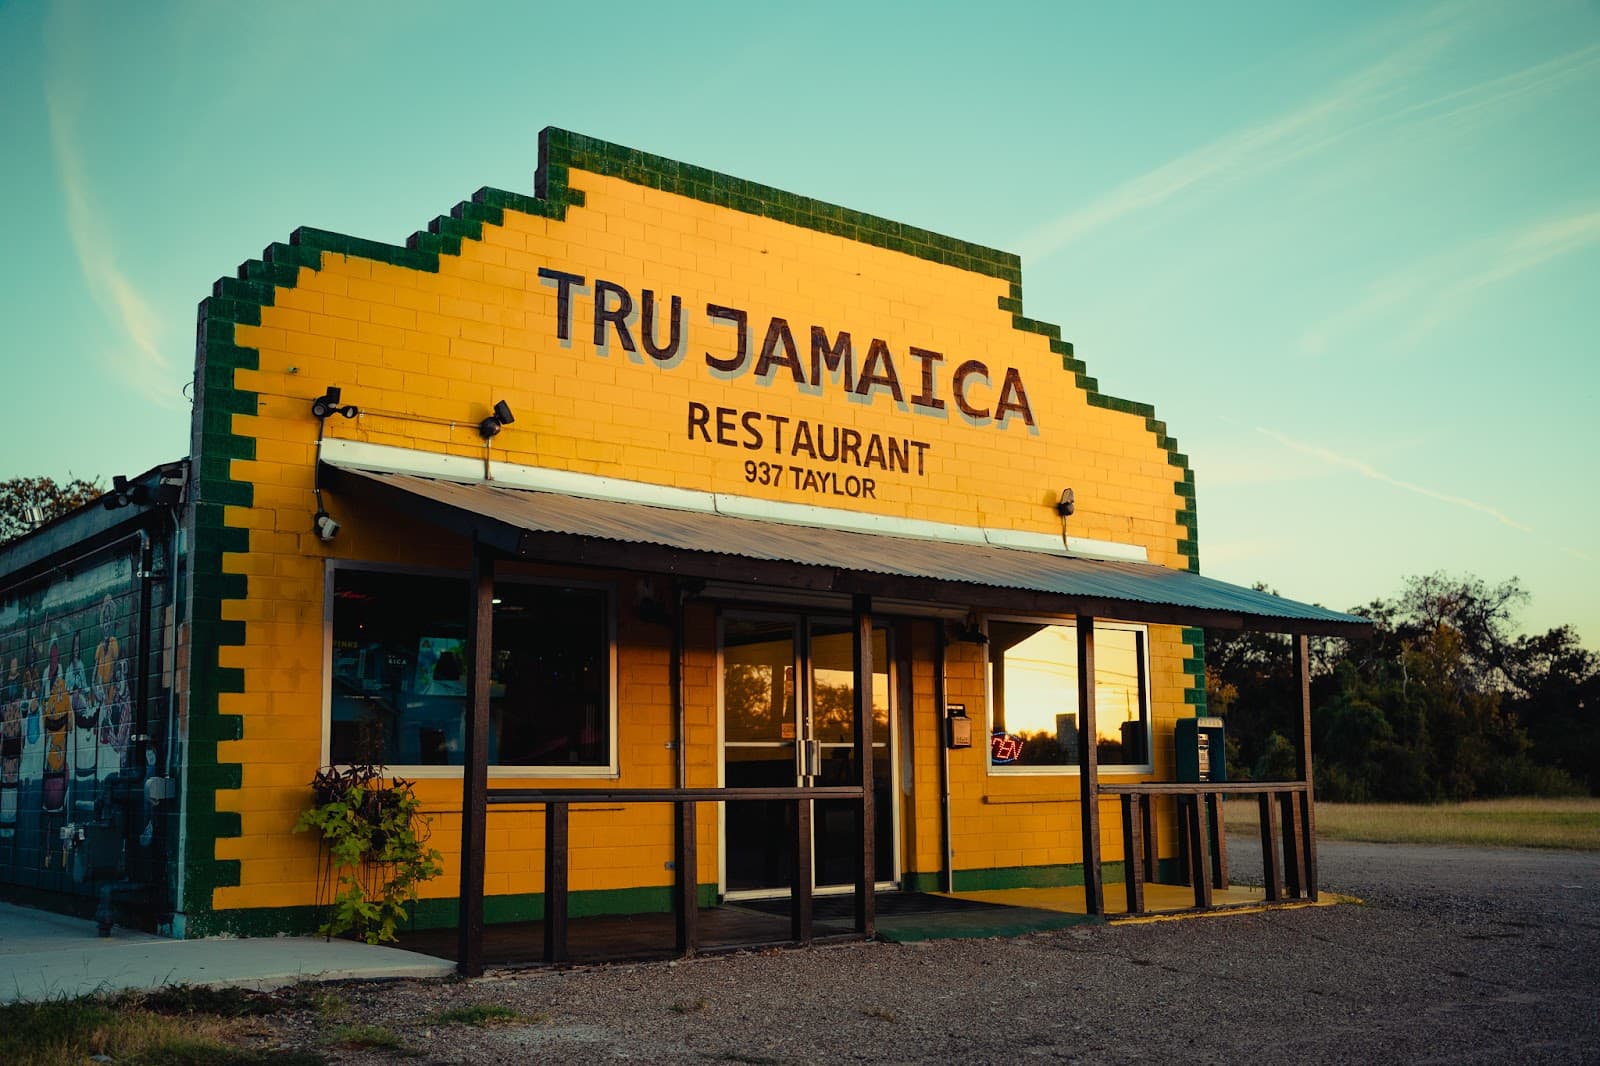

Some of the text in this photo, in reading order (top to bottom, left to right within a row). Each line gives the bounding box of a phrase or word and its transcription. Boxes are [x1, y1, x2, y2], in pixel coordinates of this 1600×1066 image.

[537, 266, 1037, 428] TRU JAMAICA
[687, 401, 931, 477] RESTAURANT
[743, 459, 878, 500] 937 TAYLOR
